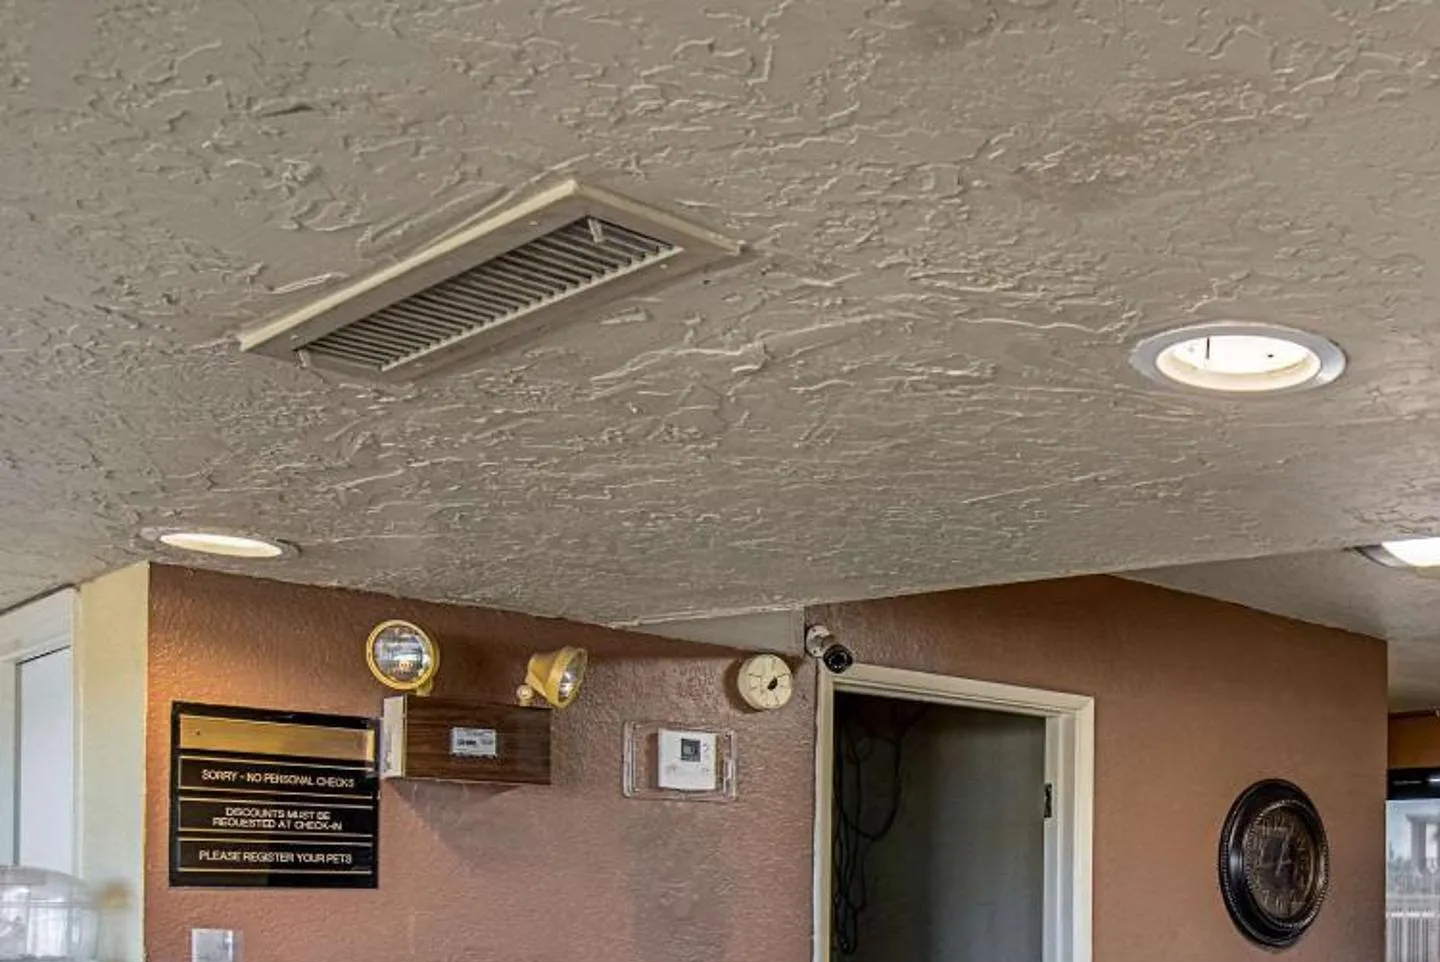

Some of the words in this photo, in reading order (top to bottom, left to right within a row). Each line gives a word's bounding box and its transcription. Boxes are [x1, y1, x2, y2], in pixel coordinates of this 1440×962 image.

[202, 769, 238, 781] SORRY
[246, 772, 262, 783] NO
[225, 807, 285, 818] DISCOUNTS
[277, 820, 292, 830] AT
[199, 850, 241, 862] PLEASE
[243, 851, 295, 864] REGISTER
[296, 853, 325, 865] YOUR
[326, 854, 352, 865] PETS
